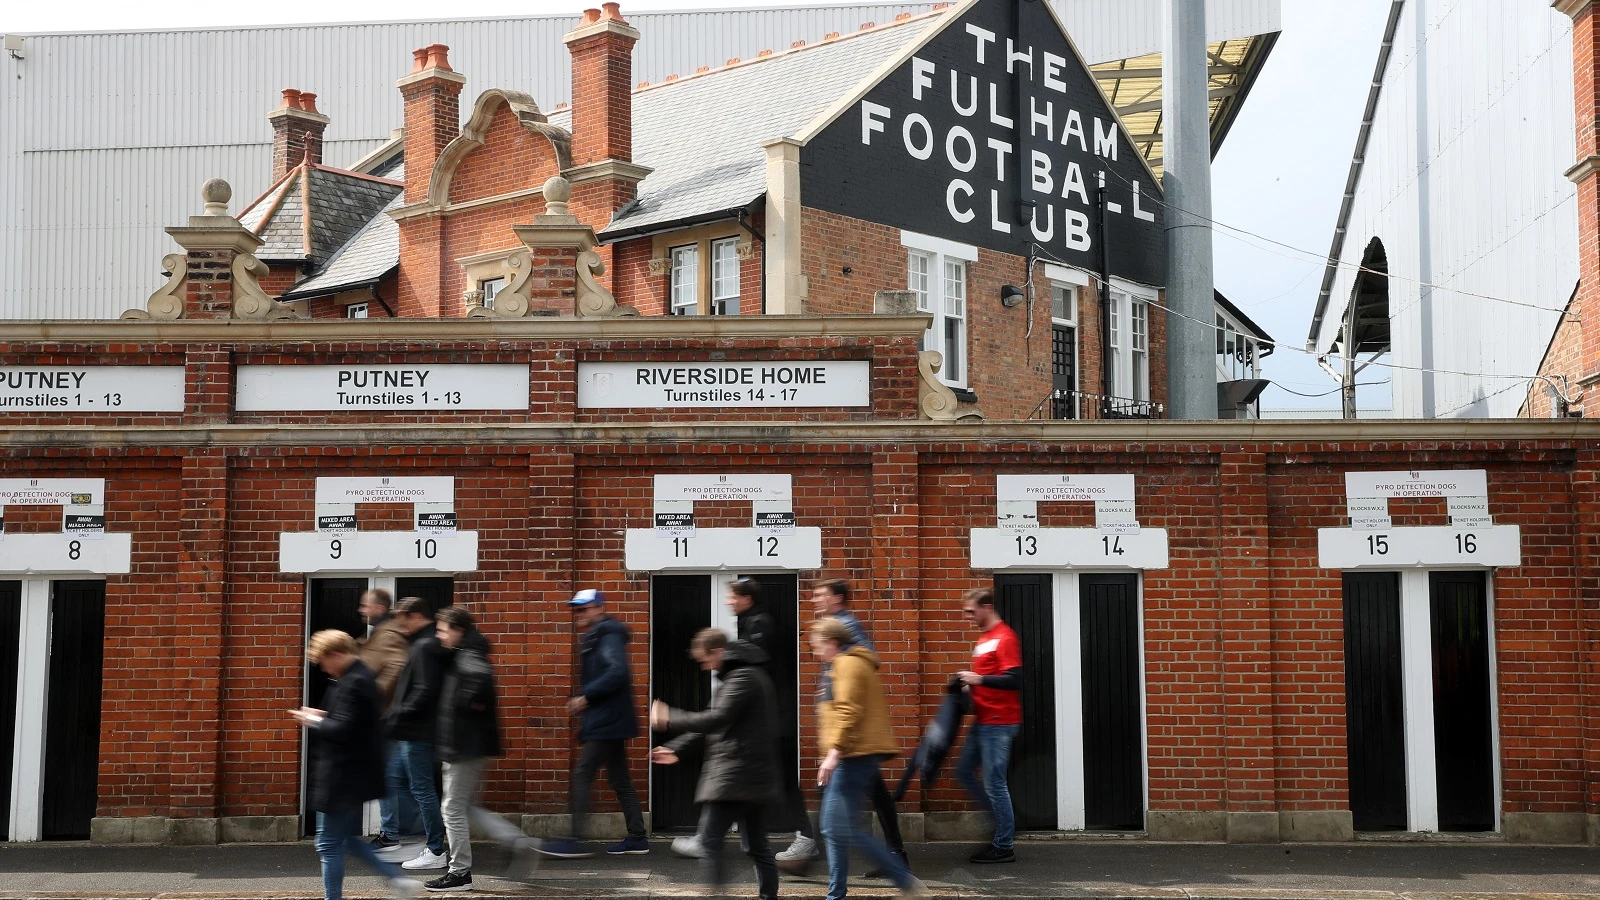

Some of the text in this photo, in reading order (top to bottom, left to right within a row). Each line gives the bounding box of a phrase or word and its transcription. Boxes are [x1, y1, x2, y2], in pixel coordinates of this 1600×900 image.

[966, 22, 1066, 94] THE
[912, 56, 1118, 161] FULHAM
[861, 99, 1155, 223] FOOTBALL
[946, 178, 1092, 252] CLUB
[337, 370, 430, 388] PUTNEY
[636, 367, 826, 385] RIVERSIDE HOME
[75, 393, 81, 406] 1
[103, 393, 122, 406] 13
[337, 391, 414, 405] Turnstiles
[421, 391, 428, 404] 1
[444, 391, 462, 405] 13
[664, 388, 741, 402] Turnstiles
[747, 388, 765, 402] 14
[781, 388, 798, 401] 17
[69, 540, 81, 560] 8
[330, 540, 342, 560] 9
[415, 539, 437, 558] 10
[673, 538, 688, 558] 11
[756, 536, 778, 557] 12
[1016, 536, 1038, 556] 13
[1102, 536, 1124, 556] 14
[1367, 534, 1389, 556] 15
[1455, 533, 1477, 554] 16
